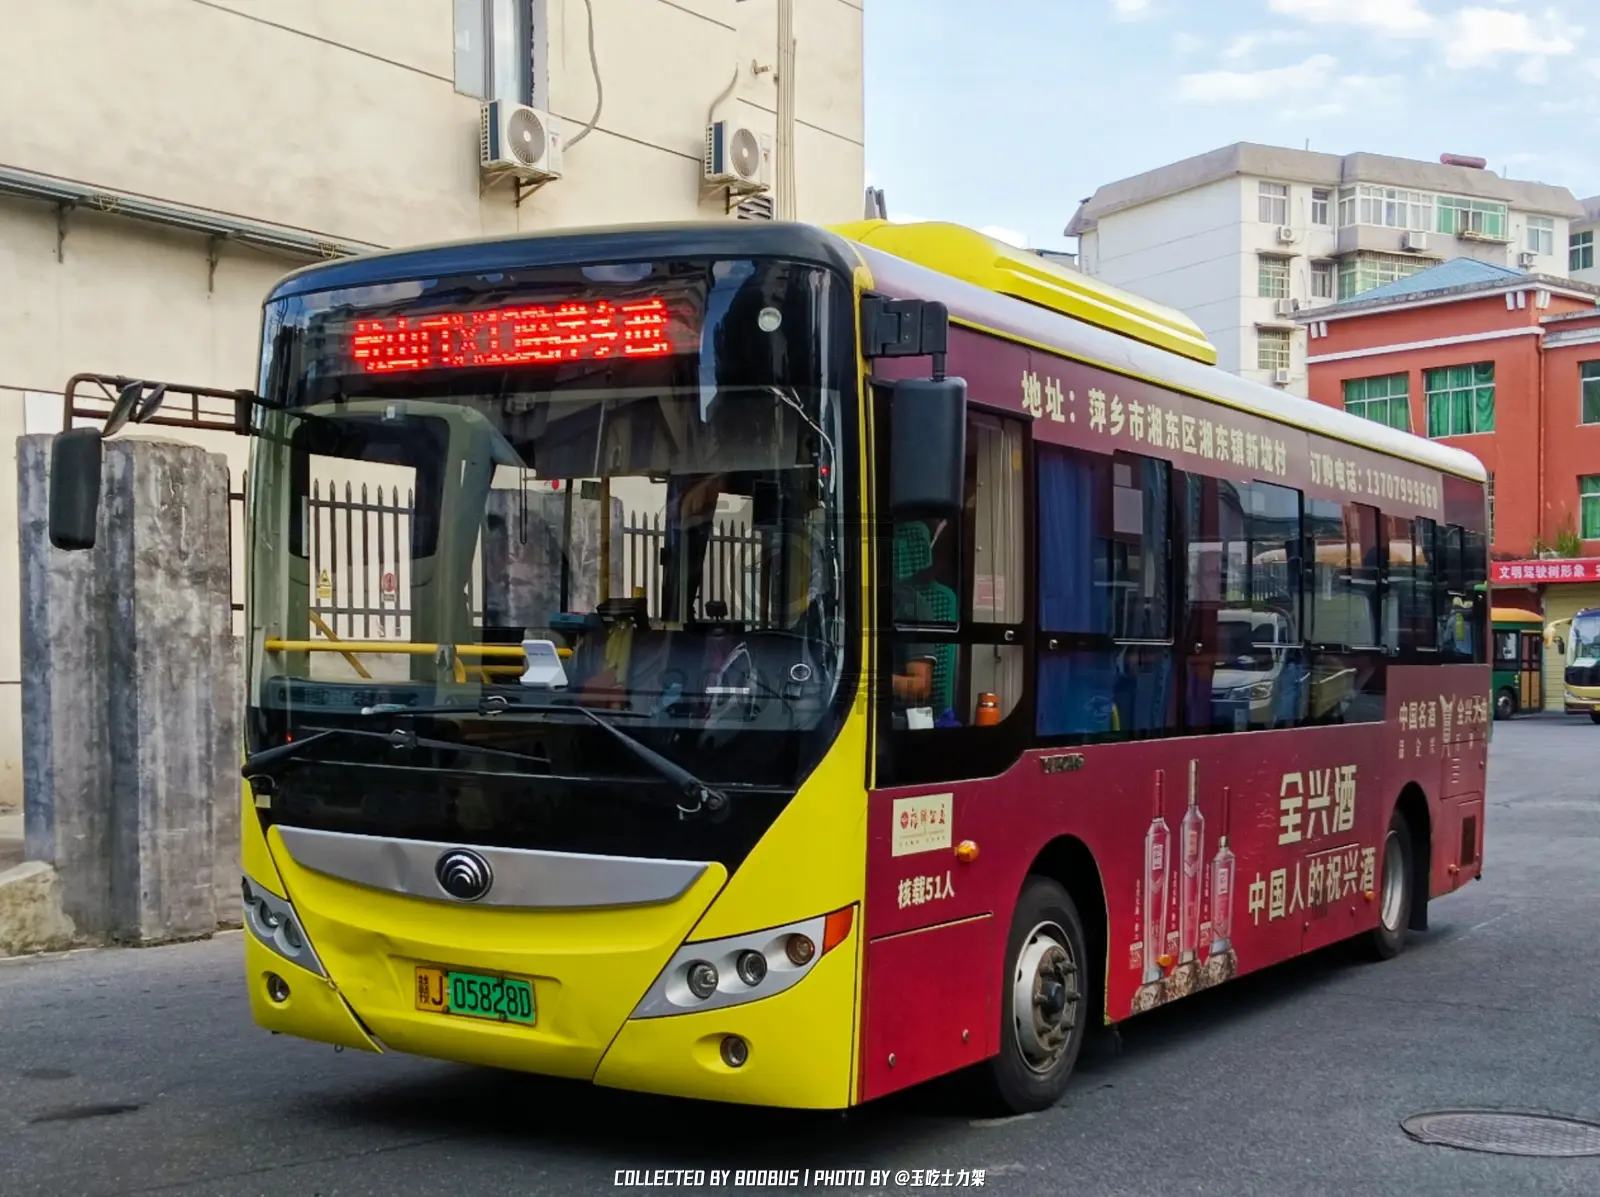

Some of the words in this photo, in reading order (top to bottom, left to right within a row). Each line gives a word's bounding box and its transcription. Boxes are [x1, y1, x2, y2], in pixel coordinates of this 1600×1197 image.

[1278, 765, 1357, 845] 全兴酒
[898, 870, 955, 909] 核载51人
[1249, 847, 1376, 926] 中国人的祝兴酒
